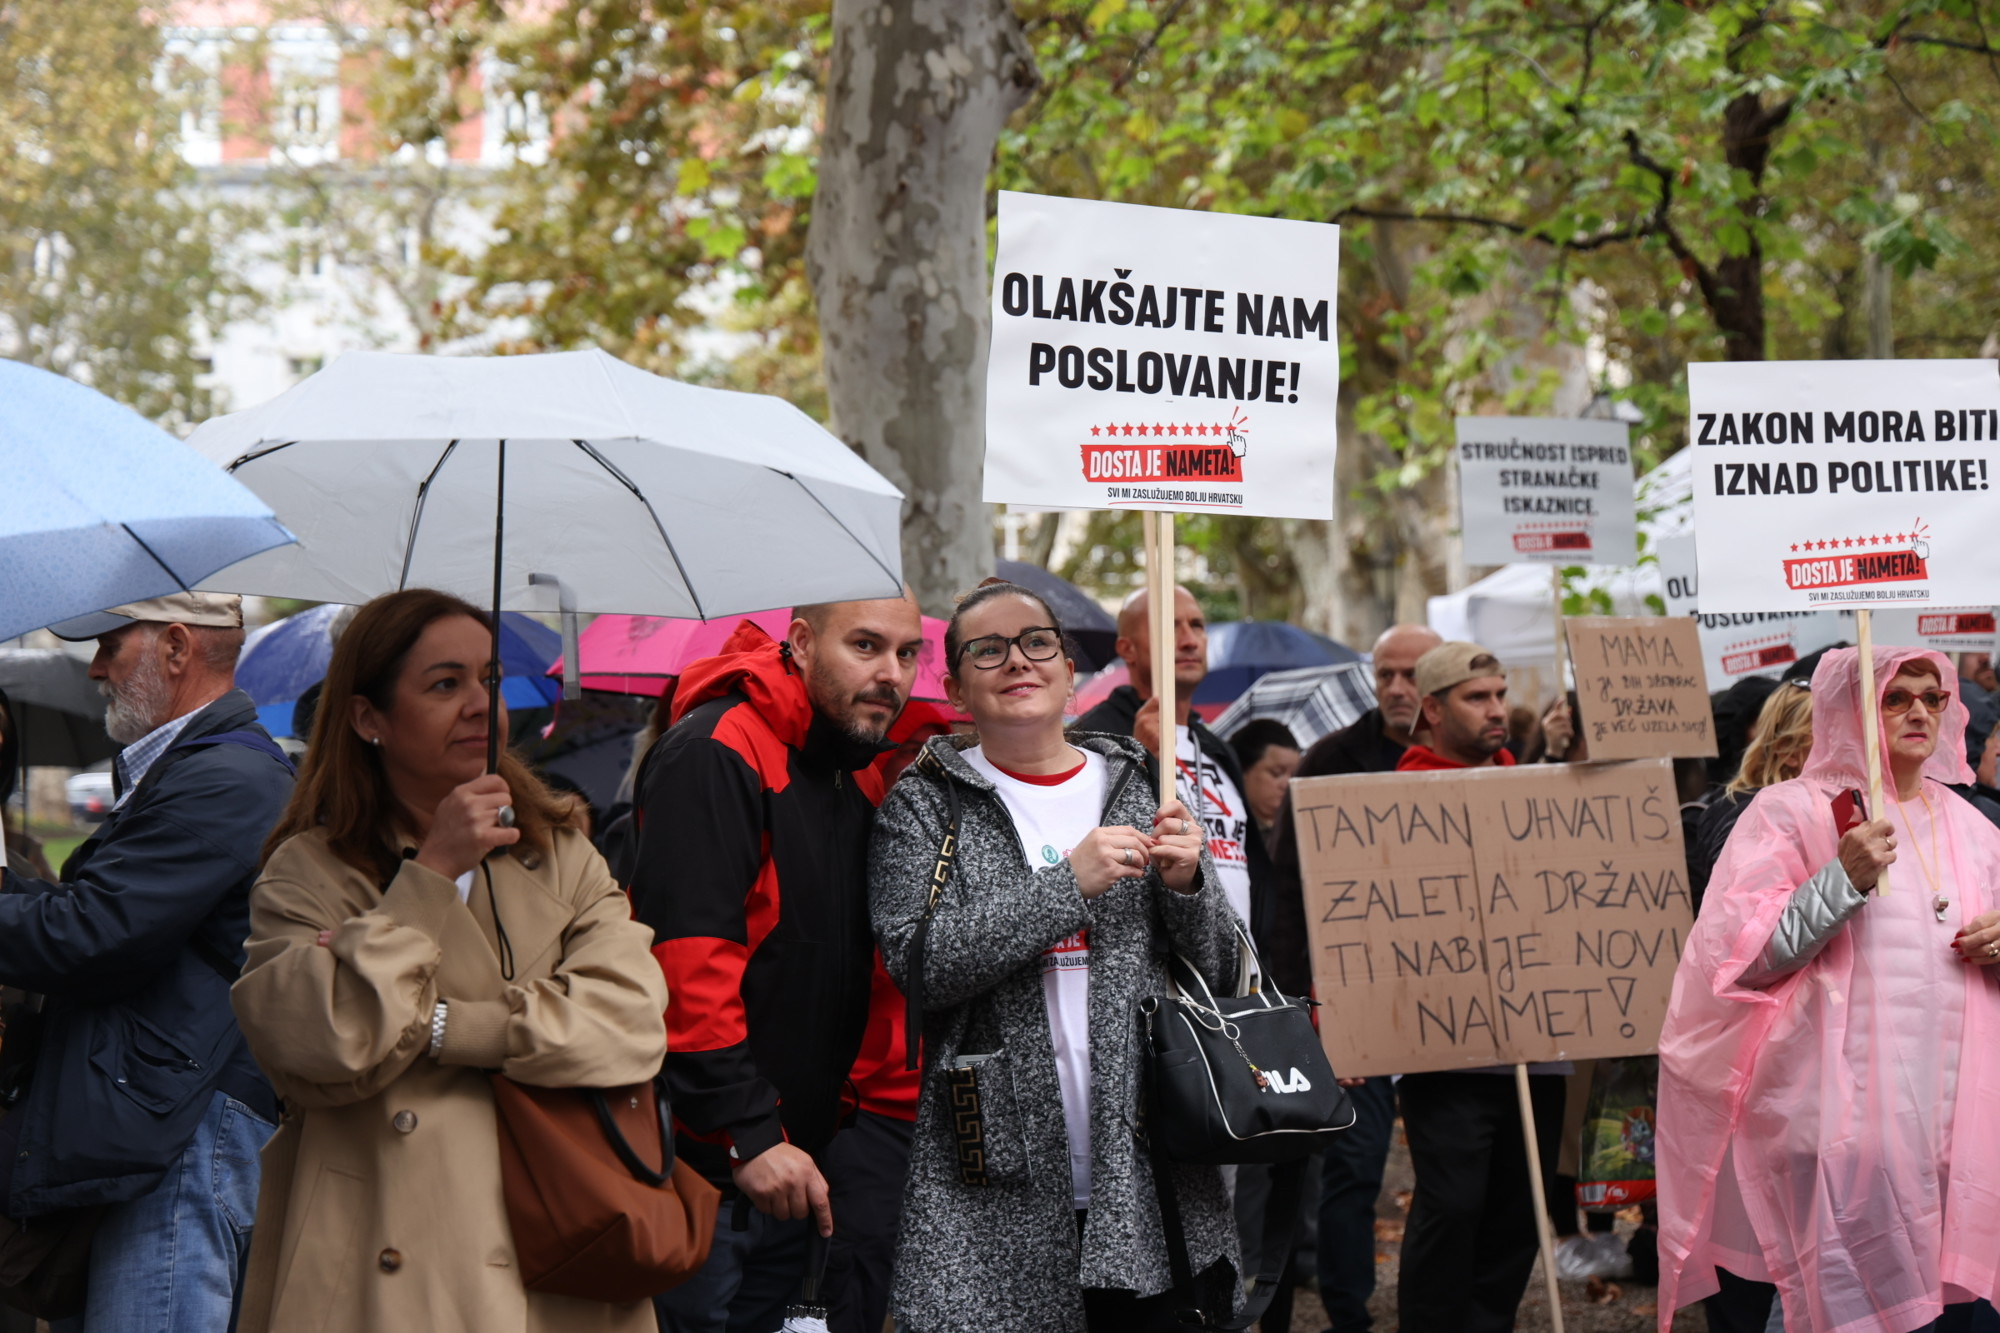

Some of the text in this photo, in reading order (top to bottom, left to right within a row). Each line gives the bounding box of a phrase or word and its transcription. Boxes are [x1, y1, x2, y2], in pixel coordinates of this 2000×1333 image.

[1002, 267, 1329, 342] OLAKŠAJTE NAM
[1029, 342, 1301, 404] POSLOVANJE!
[1697, 409, 1998, 446] ZAKON MORA BITI
[1089, 449, 1235, 478] DOSTA JE NAMETA!
[1461, 437, 1628, 466] STRUČNOST ISPRED
[1499, 465, 1599, 490] STRANAČKE
[1714, 459, 1989, 496] IZNAD POLITIKE!
[1107, 487, 1243, 505] SVI MI ZASLUŽUJEMO BOLJU HRVATSKU
[1791, 553, 1920, 588] DOSTA JE NAMETA!
[1667, 576, 1698, 599] OL
[1808, 590, 1930, 601] SVI MI ZASLUŽUJEMO BOLJU HRVATSKU
[1611, 694, 1679, 717] DRŽAVA
[1592, 721, 1608, 742] JE
[1642, 720, 1680, 733] UZELA
[1297, 785, 1671, 853] TAMAN UHVATIŠ
[1321, 859, 1692, 923] ZALET, A DRŽAVA
[1324, 926, 1682, 992] TI NABIJE NOVI
